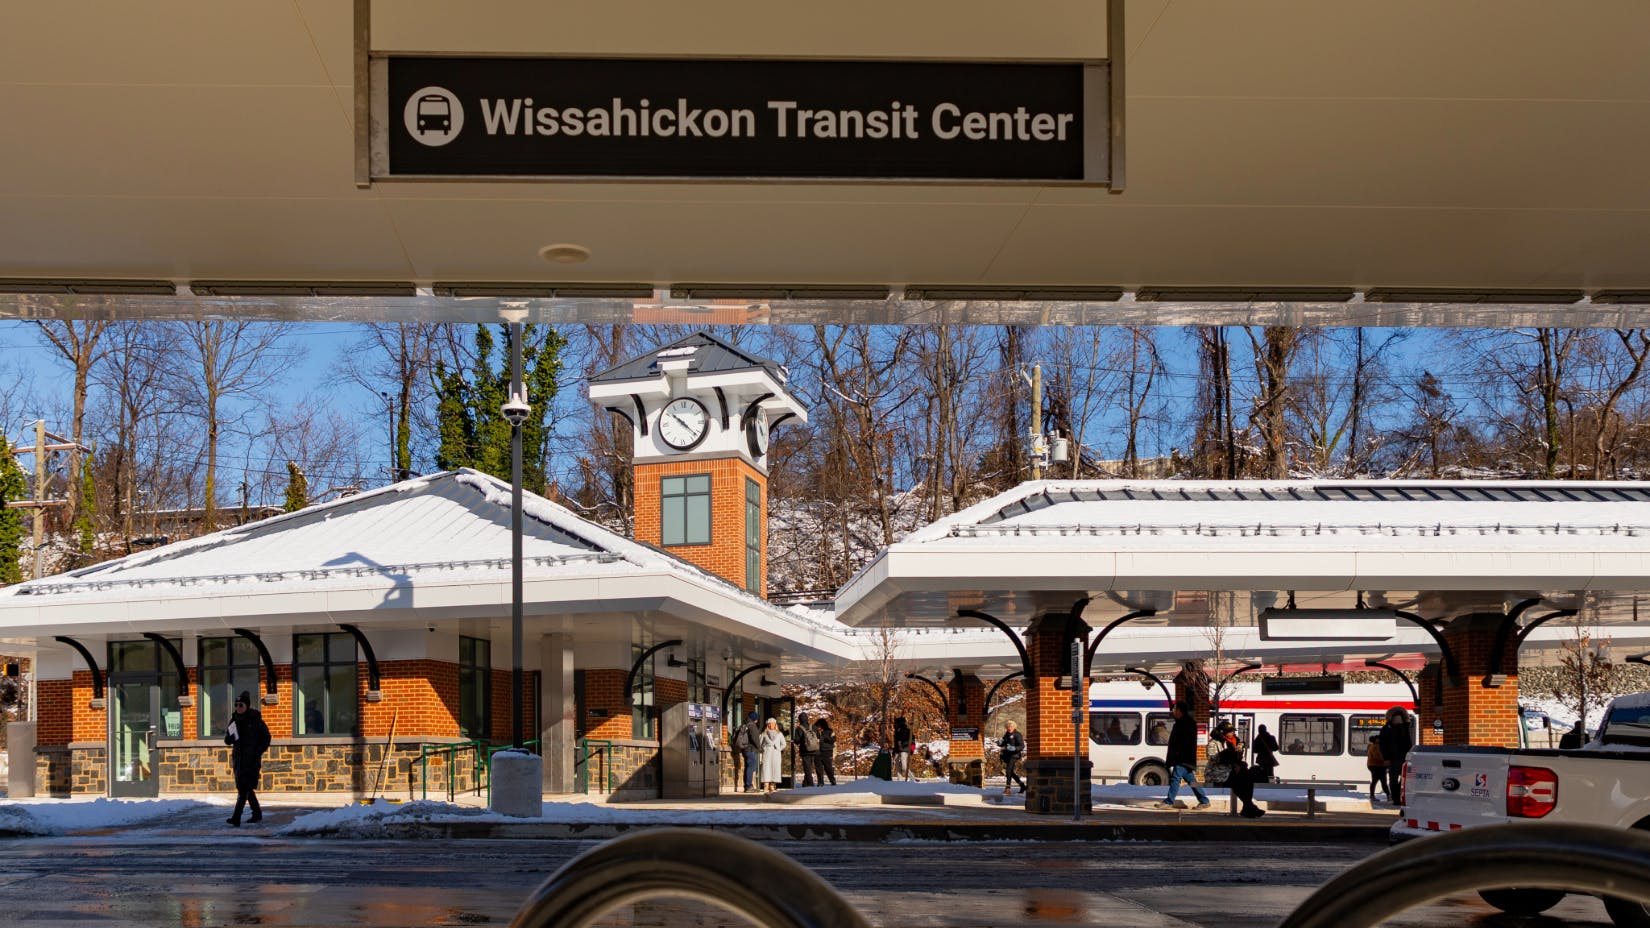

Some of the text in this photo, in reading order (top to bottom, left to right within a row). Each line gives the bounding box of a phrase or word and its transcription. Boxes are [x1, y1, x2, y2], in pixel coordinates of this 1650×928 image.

[479, 97, 1074, 141] Wissahickon Transit Center
[1471, 788, 1490, 798] SEPTA
